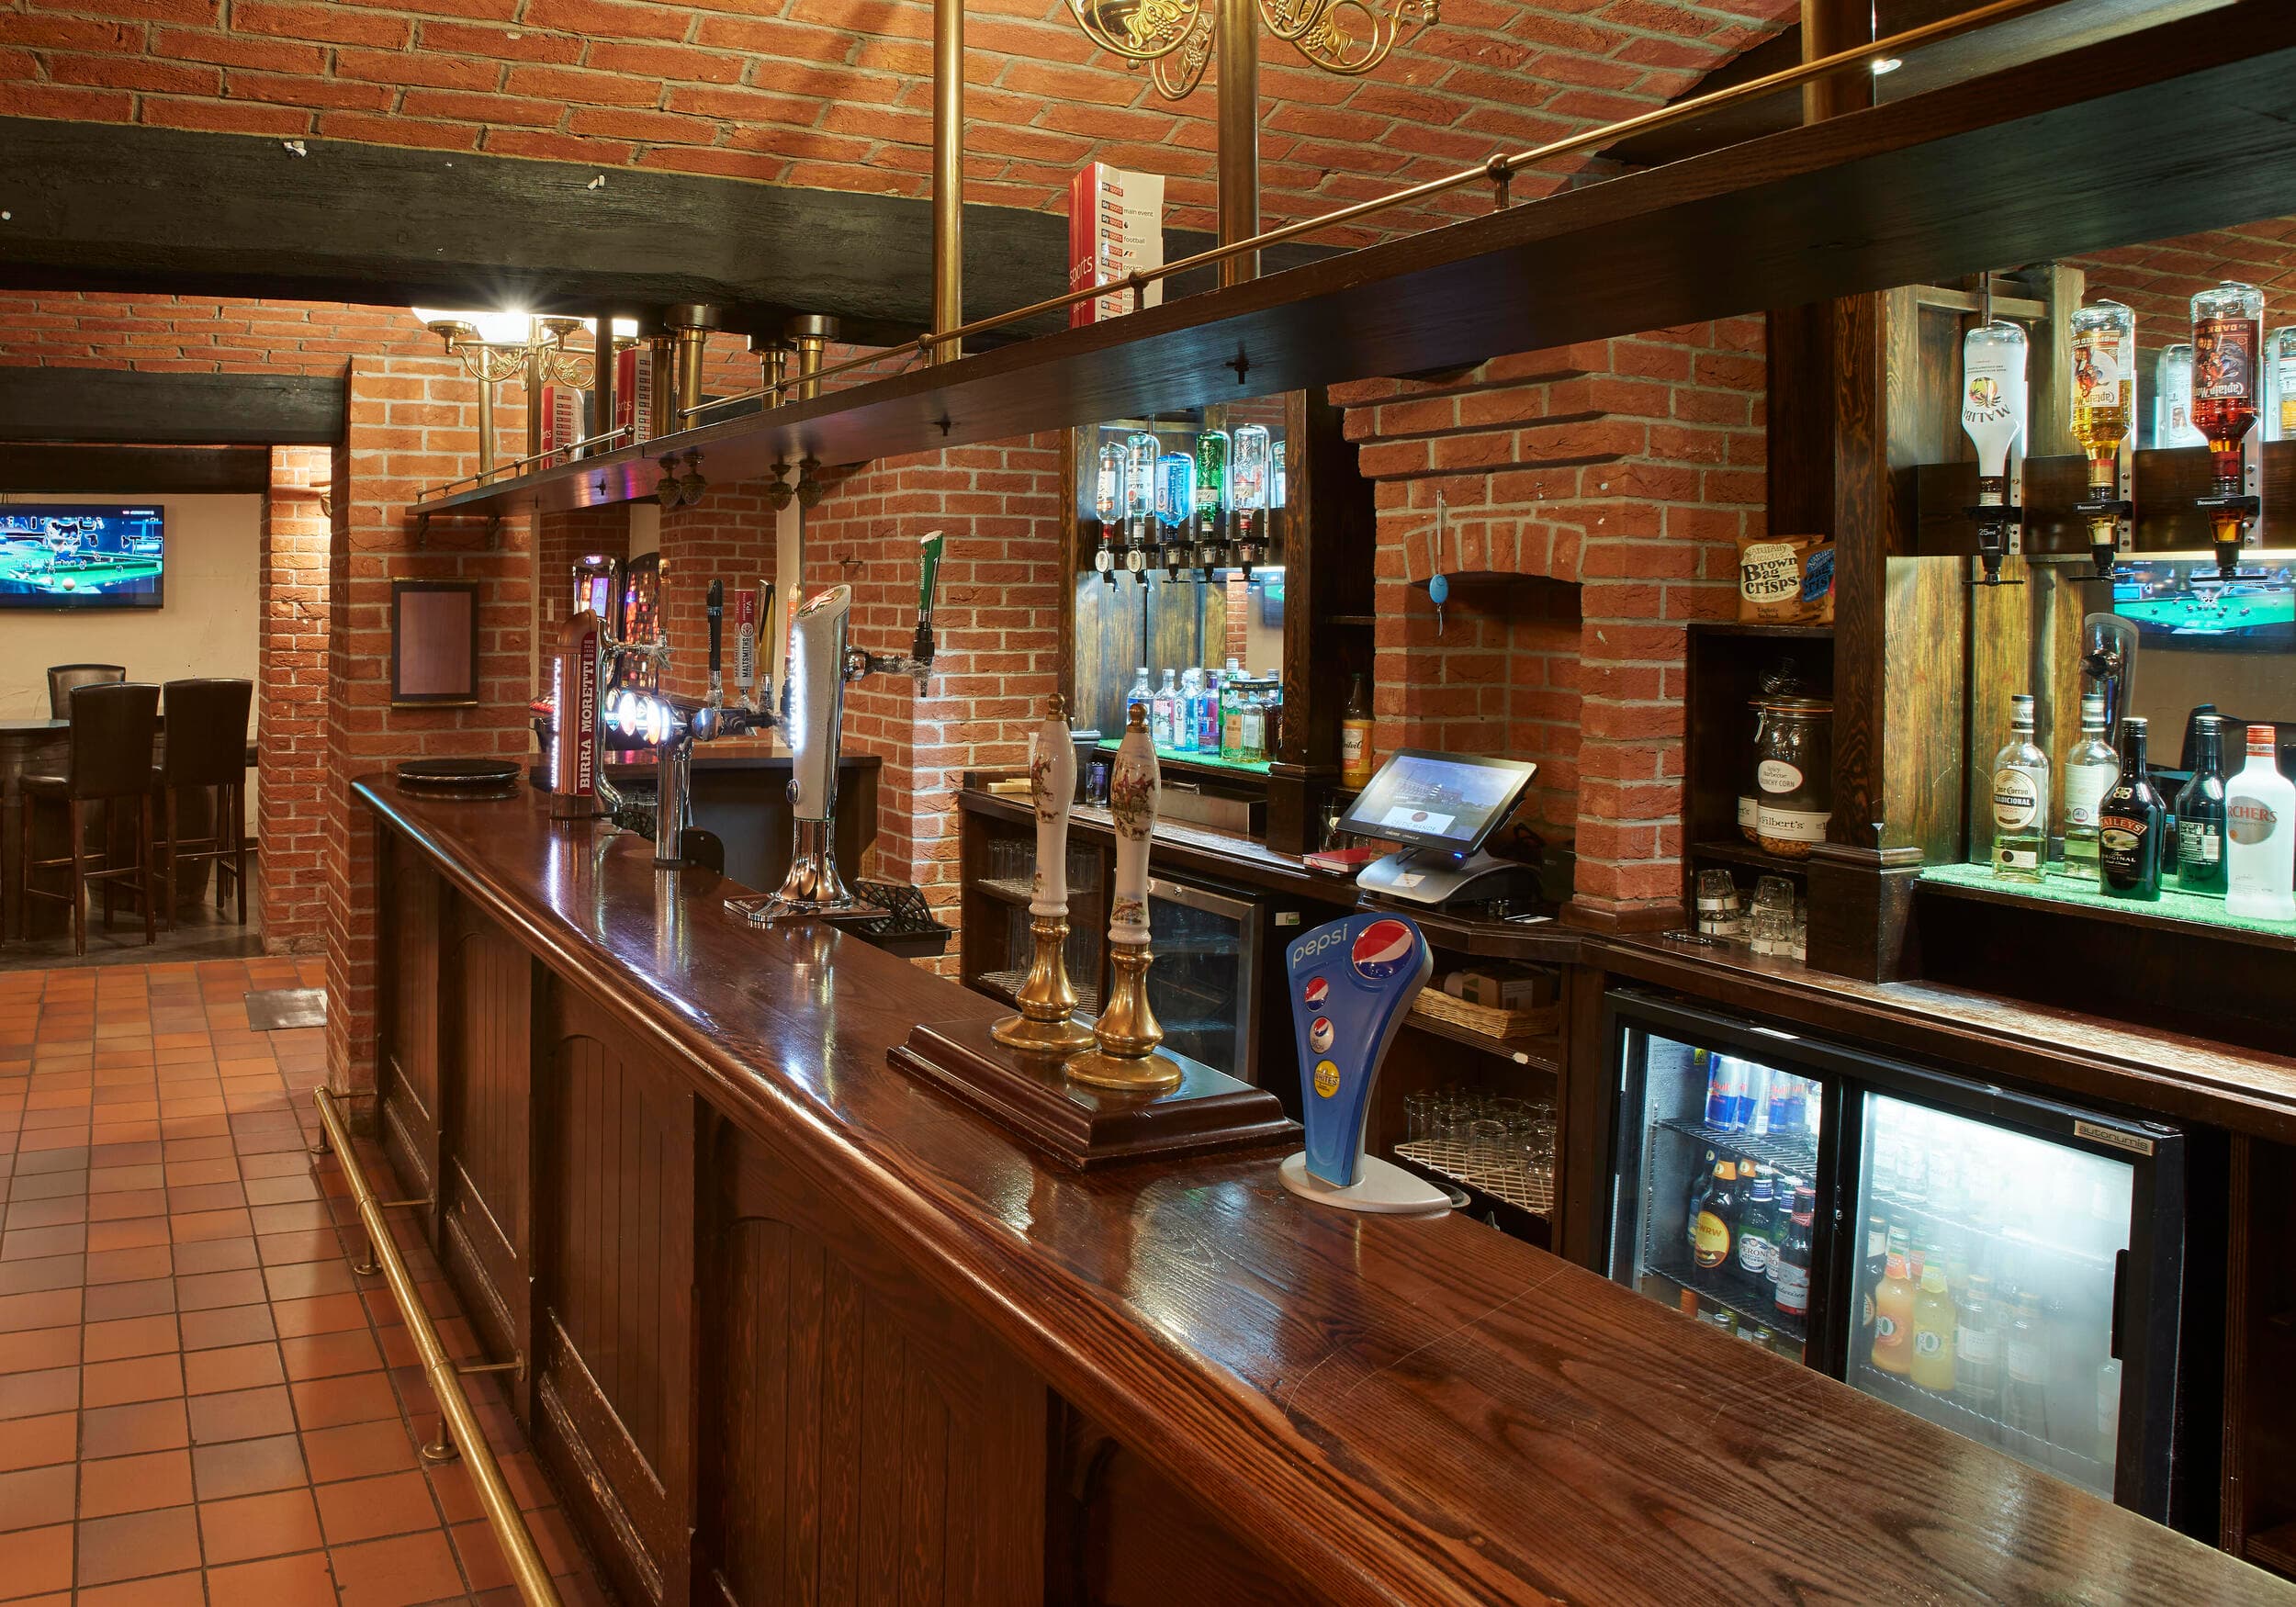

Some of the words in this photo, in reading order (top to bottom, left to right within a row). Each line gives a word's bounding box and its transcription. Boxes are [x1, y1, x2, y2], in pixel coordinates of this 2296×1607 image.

[1123, 235, 1145, 244] football
[1070, 256, 1093, 287] sports
[2208, 323, 2237, 332] DARK
[2085, 391, 2115, 404] Captain
[2211, 382, 2243, 397] Captain
[1742, 557, 1797, 583] Brown
[581, 660, 594, 733] MORETTI
[580, 738, 591, 789] BIRRA
[2227, 805, 2278, 824] RCHERS
[2100, 817, 2143, 832] BAILEYS
[1293, 923, 1348, 969] pepsi
[2078, 1125, 2148, 1149] autonumis
[1698, 1223, 1722, 1237] WRW
